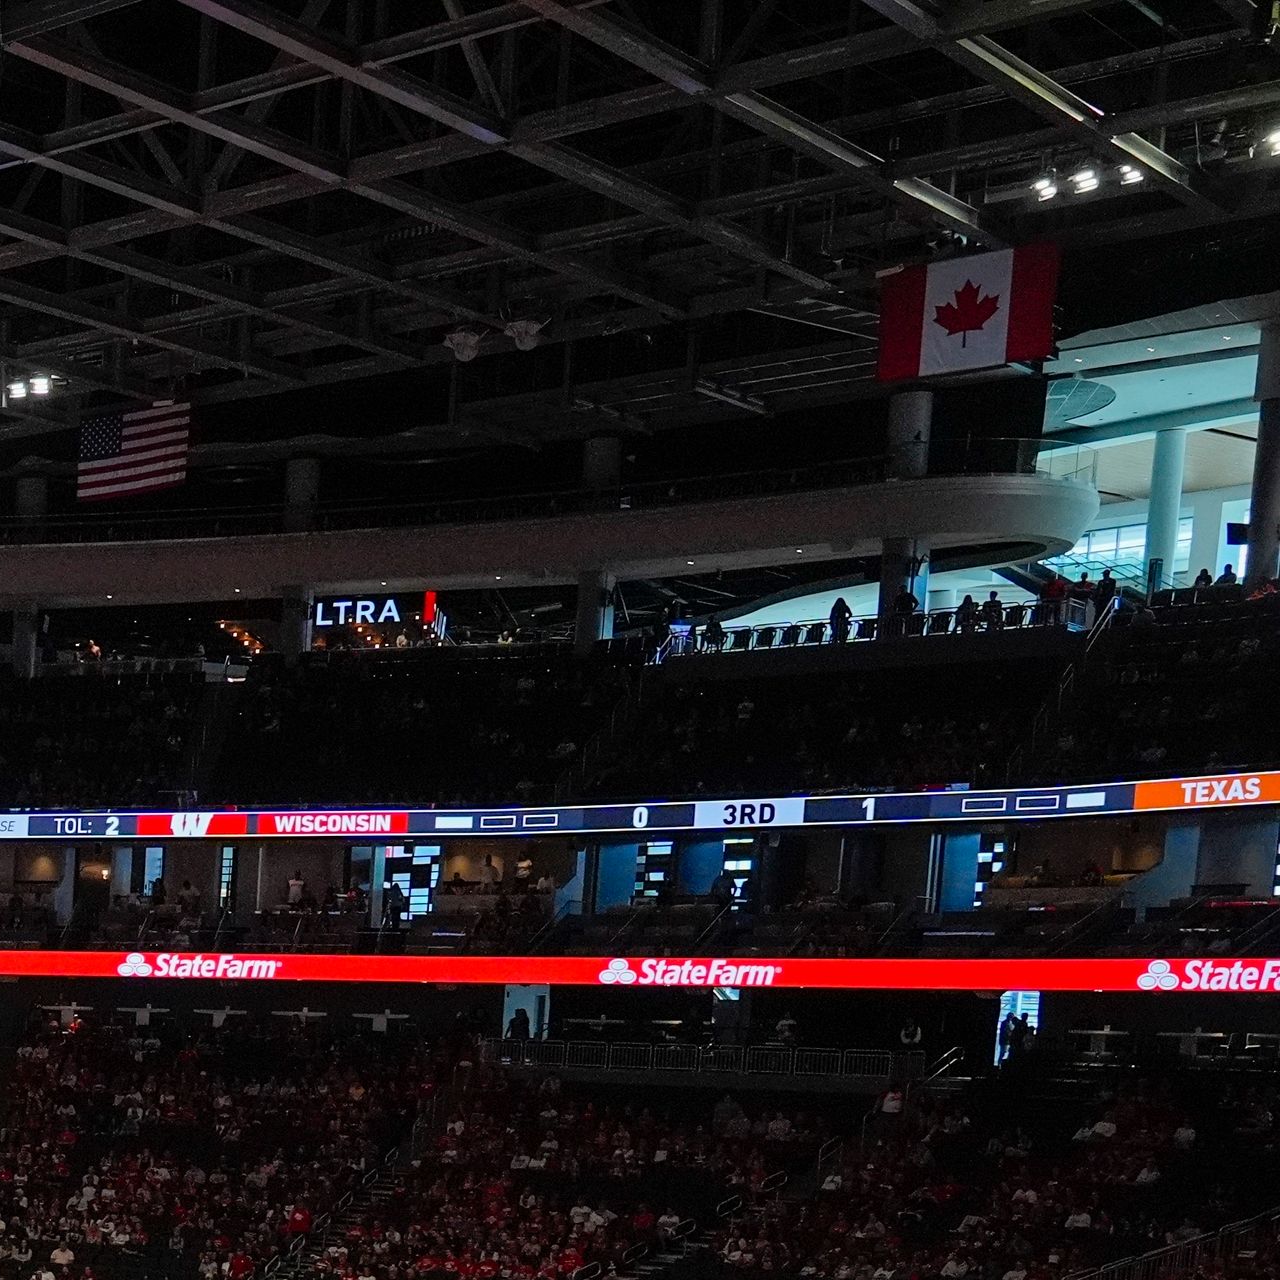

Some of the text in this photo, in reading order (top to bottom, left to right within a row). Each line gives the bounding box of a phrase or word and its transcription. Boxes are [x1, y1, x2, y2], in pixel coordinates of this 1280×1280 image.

[316, 598, 402, 627] LTRA
[274, 813, 391, 833] WISCONSIN
[632, 806, 649, 829] 0
[722, 802, 776, 825] 3RD
[860, 797, 877, 821] 1
[1181, 777, 1263, 804] TEXAS
[53, 817, 120, 836] TOL: 2
